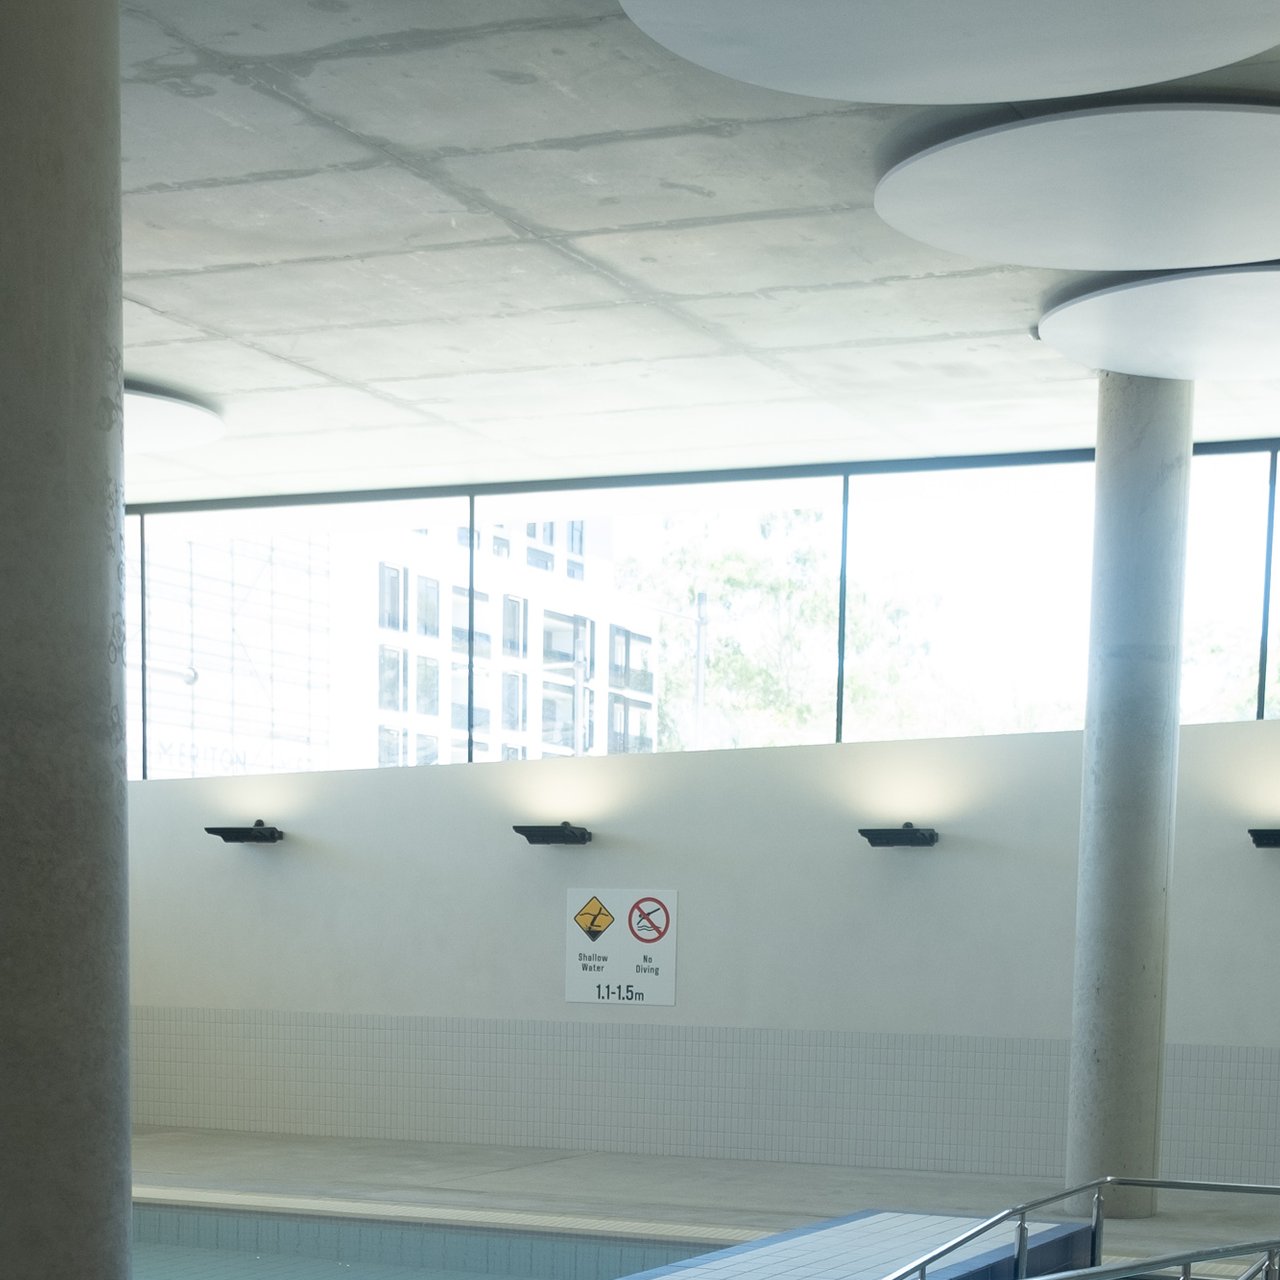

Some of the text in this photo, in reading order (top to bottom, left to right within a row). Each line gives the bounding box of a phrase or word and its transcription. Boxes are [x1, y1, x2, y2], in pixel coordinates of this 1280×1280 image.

[578, 952, 609, 962] Shallow
[642, 954, 653, 964] No
[581, 963, 605, 972] Water
[635, 964, 660, 977] Diving
[596, 983, 645, 1001] 1.1-1.5m
